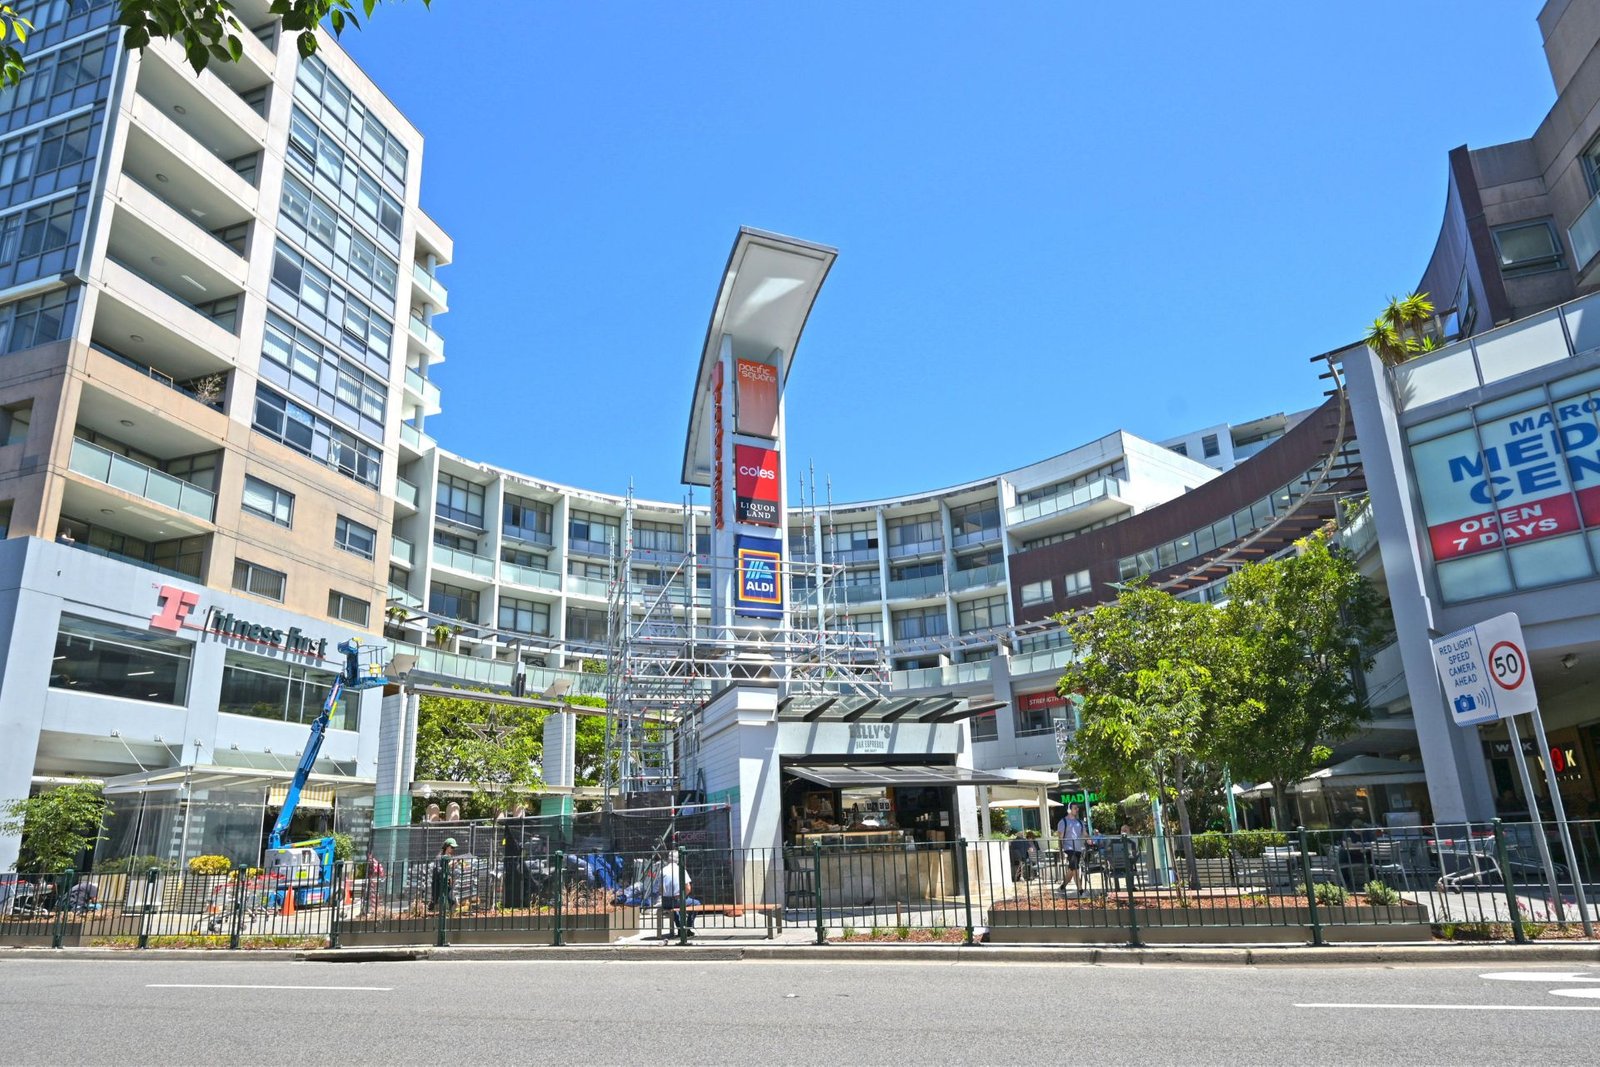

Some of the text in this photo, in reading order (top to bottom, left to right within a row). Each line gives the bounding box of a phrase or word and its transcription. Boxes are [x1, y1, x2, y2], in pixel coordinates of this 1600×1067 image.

[739, 363, 771, 376] pacific
[741, 370, 776, 383] square
[1448, 423, 1599, 483] MED
[739, 465, 775, 480] coles
[1470, 450, 1600, 504] CEN
[740, 501, 776, 513] LIQUOR
[746, 510, 771, 520] LAND
[1459, 504, 1543, 533] OPEN
[1453, 518, 1558, 551] 7 DAYS
[745, 581, 774, 593] ALDI
[203, 605, 329, 657] Fitness First
[1439, 637, 1473, 656] RED LIGHT
[1448, 651, 1470, 665] SPEED
[1494, 653, 1518, 677] 50
[1448, 662, 1477, 677] CAMERA
[1454, 674, 1478, 688] AHEAD
[1495, 743, 1532, 753] WK
[1061, 793, 1085, 803] MAD
